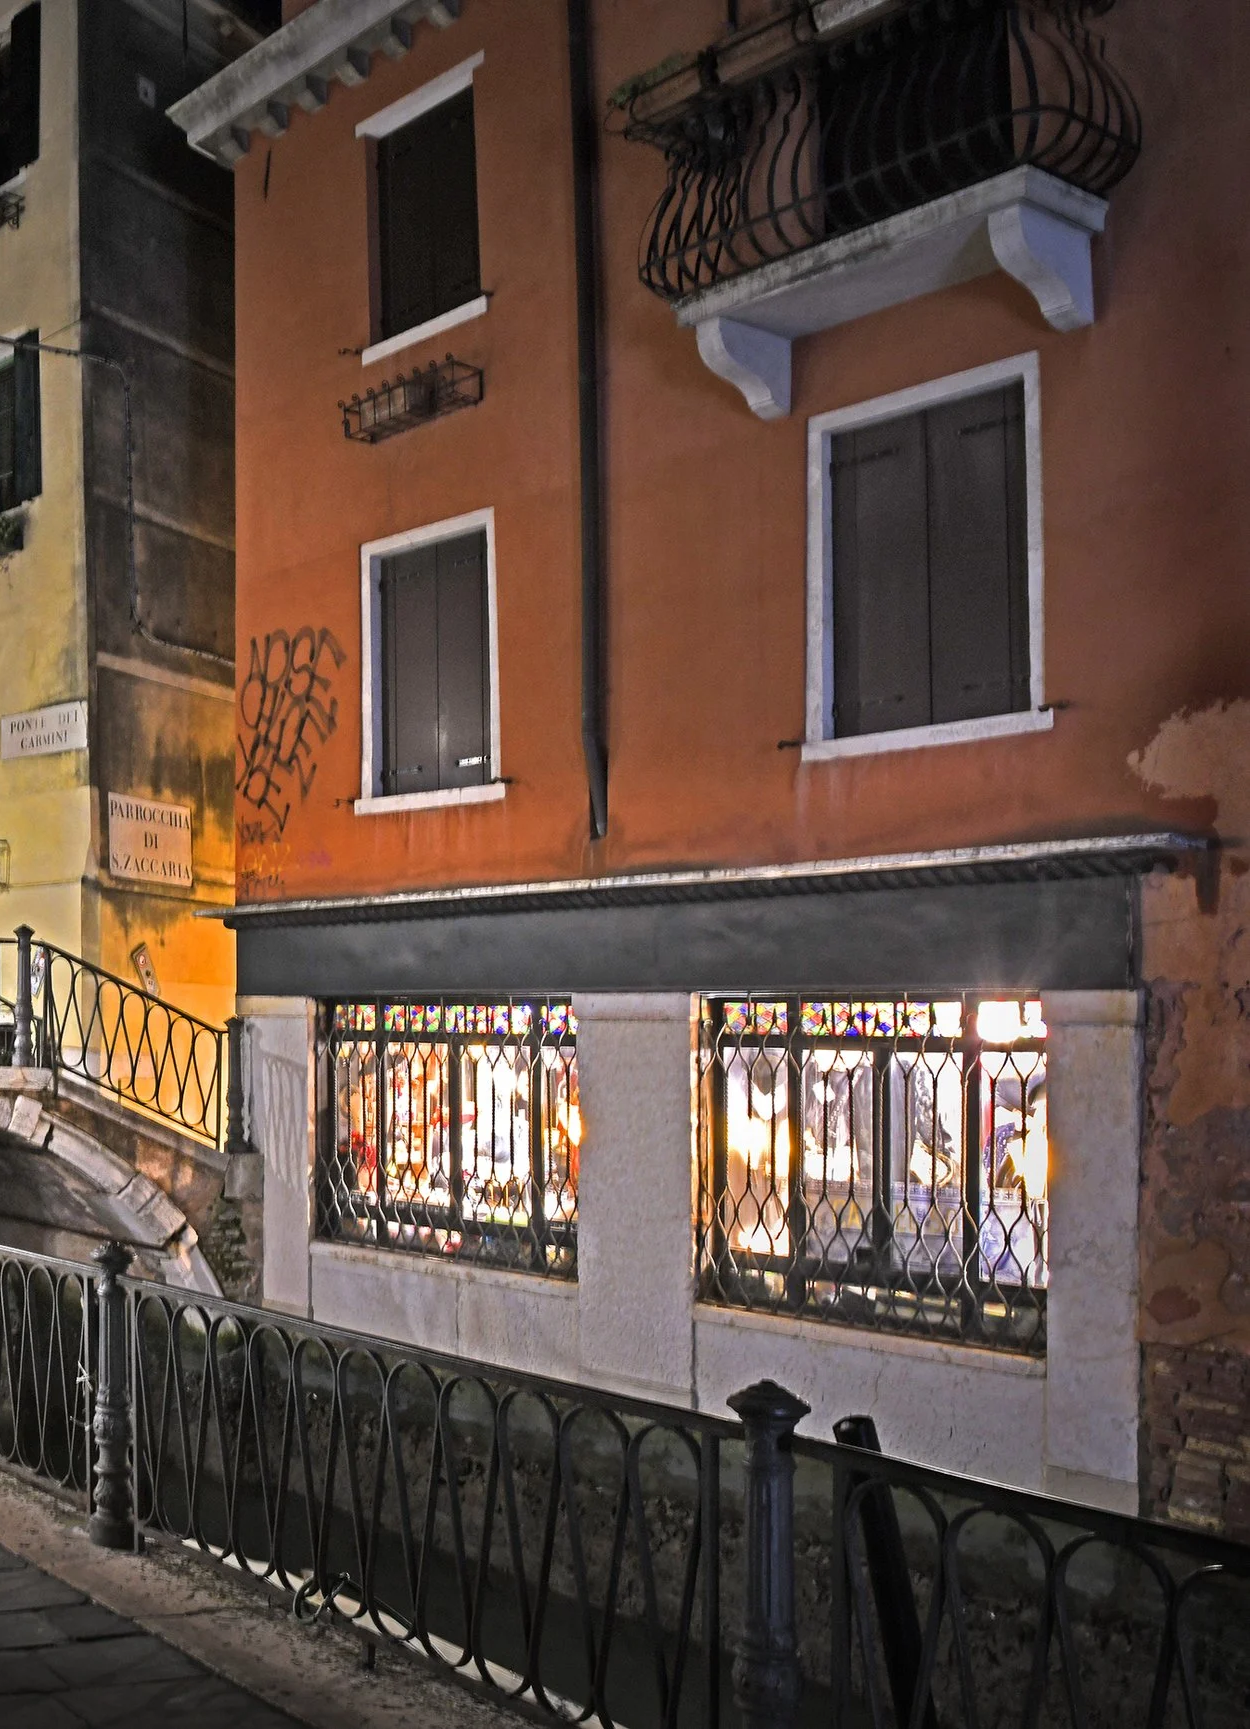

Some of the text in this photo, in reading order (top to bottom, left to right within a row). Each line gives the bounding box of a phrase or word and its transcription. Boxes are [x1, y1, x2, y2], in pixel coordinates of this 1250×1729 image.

[10, 715, 46, 735] PONTE
[20, 729, 68, 749] CARMINI
[110, 800, 191, 830] PARROCCHIA
[144, 832, 159, 849] DI
